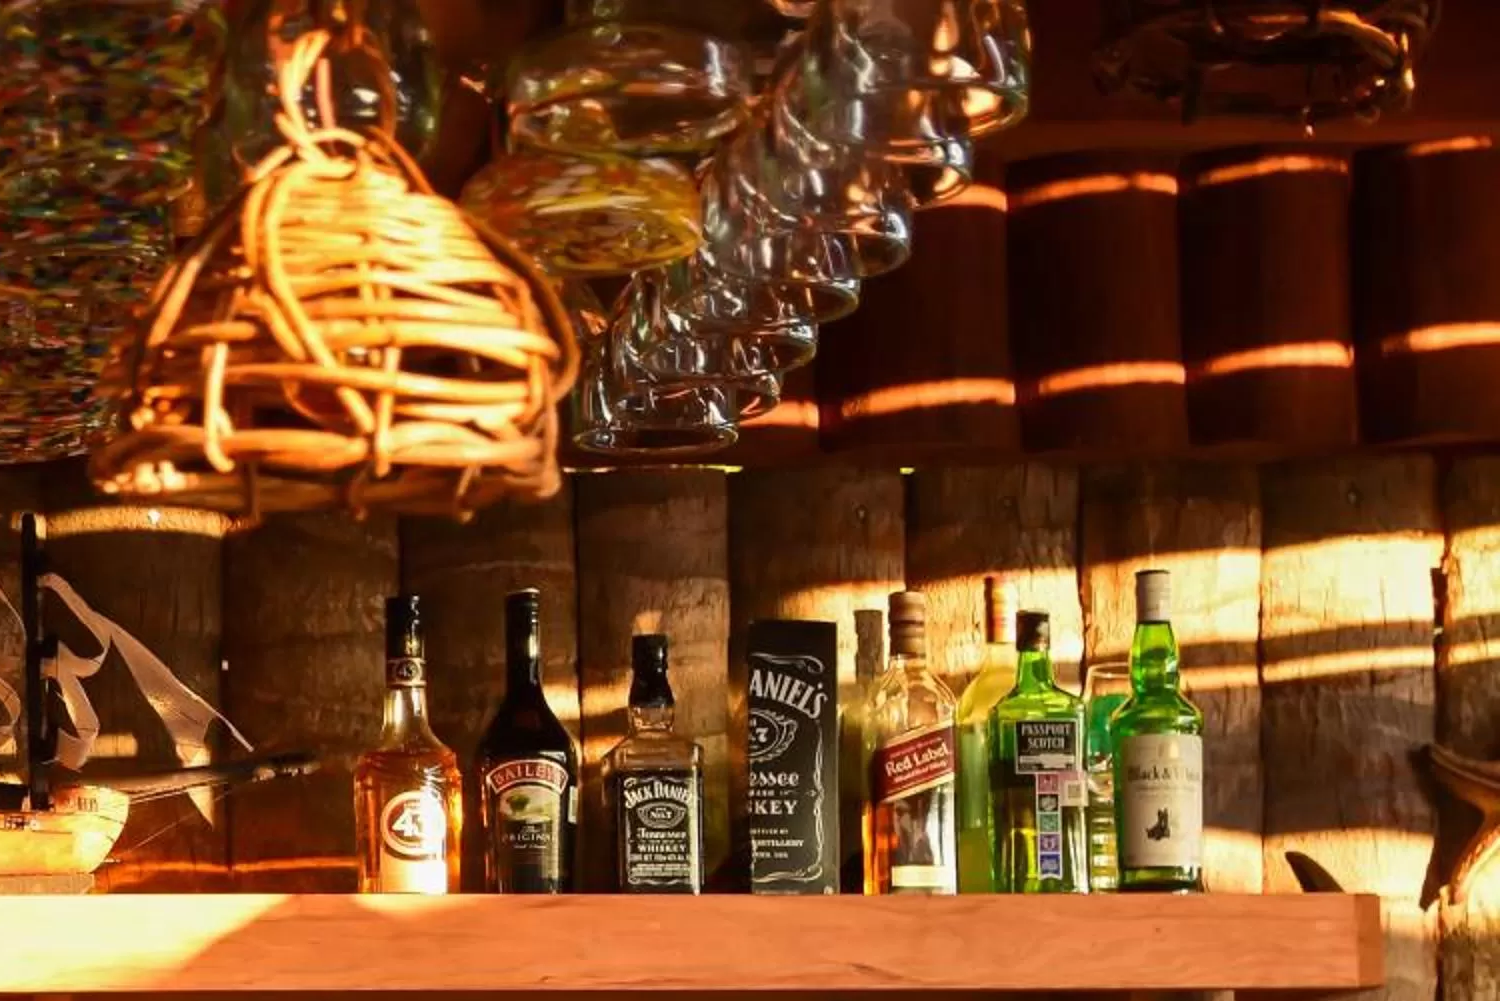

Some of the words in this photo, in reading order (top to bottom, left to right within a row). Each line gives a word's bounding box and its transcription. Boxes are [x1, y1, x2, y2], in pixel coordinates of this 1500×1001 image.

[749, 669, 828, 719] ANIEL'S
[885, 755, 913, 777] Red
[912, 741, 950, 767] Label
